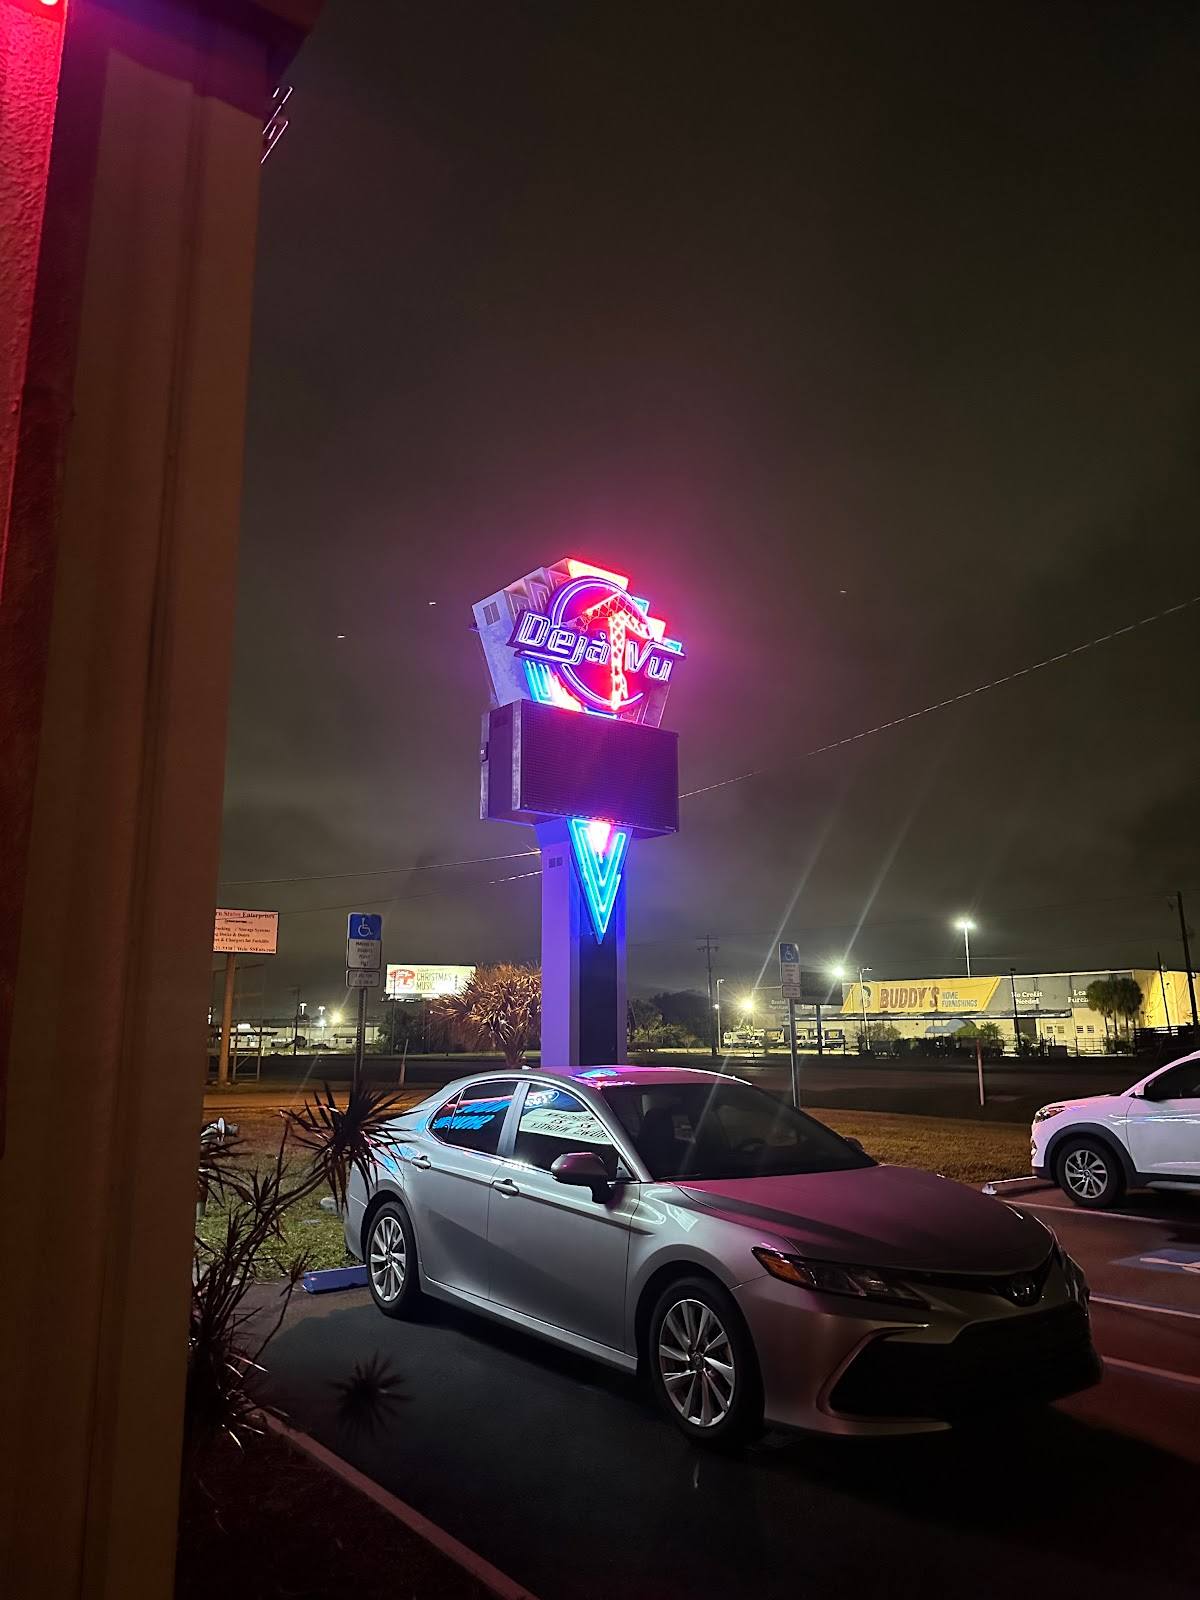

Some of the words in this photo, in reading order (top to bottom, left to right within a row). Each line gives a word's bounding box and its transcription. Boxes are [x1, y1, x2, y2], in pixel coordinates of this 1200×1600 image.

[625, 640, 684, 681] Vu
[416, 972, 452, 982] CHRISTMAS
[416, 981, 436, 991] MUSI
[880, 986, 940, 1009] BUDDY'S
[942, 991, 959, 1000] HOME
[942, 999, 978, 1008] FURNISHINGS
